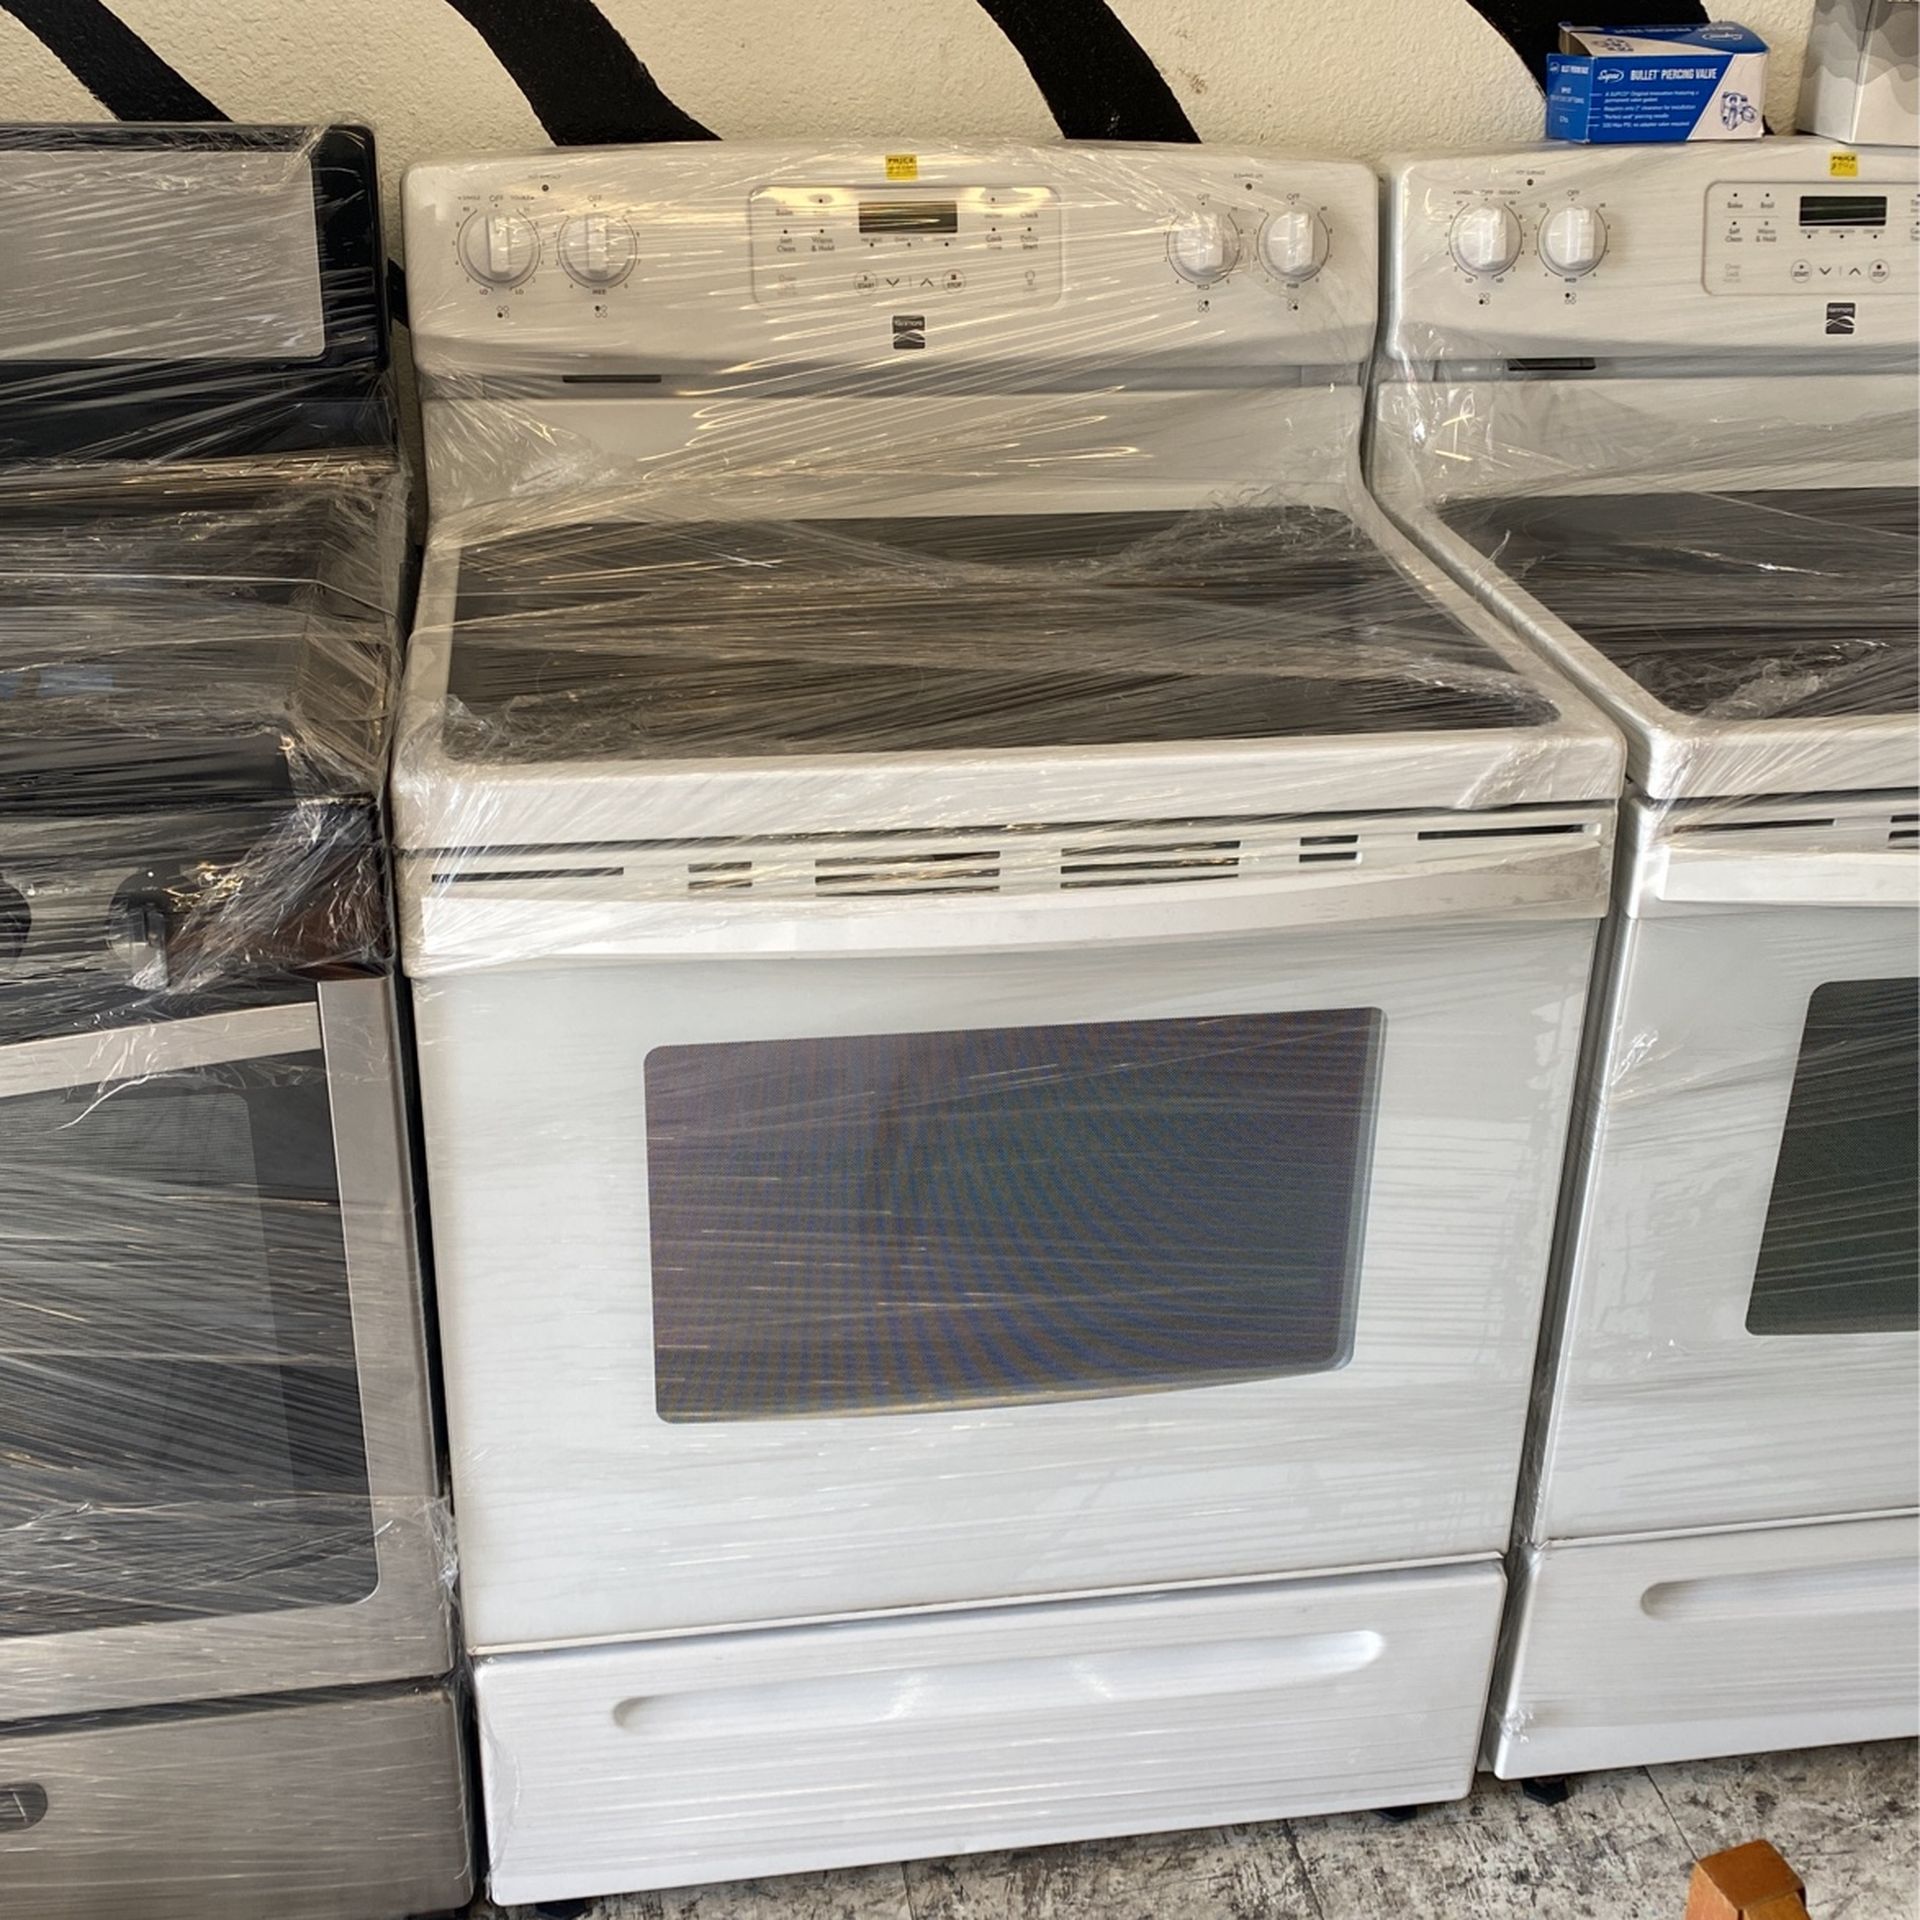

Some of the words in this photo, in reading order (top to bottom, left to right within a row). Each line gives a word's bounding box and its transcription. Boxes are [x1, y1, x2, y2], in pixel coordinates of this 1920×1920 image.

[1630, 69, 1657, 81] BULLET
[1661, 68, 1694, 80] PIERCING
[1695, 67, 1717, 79] VALVE
